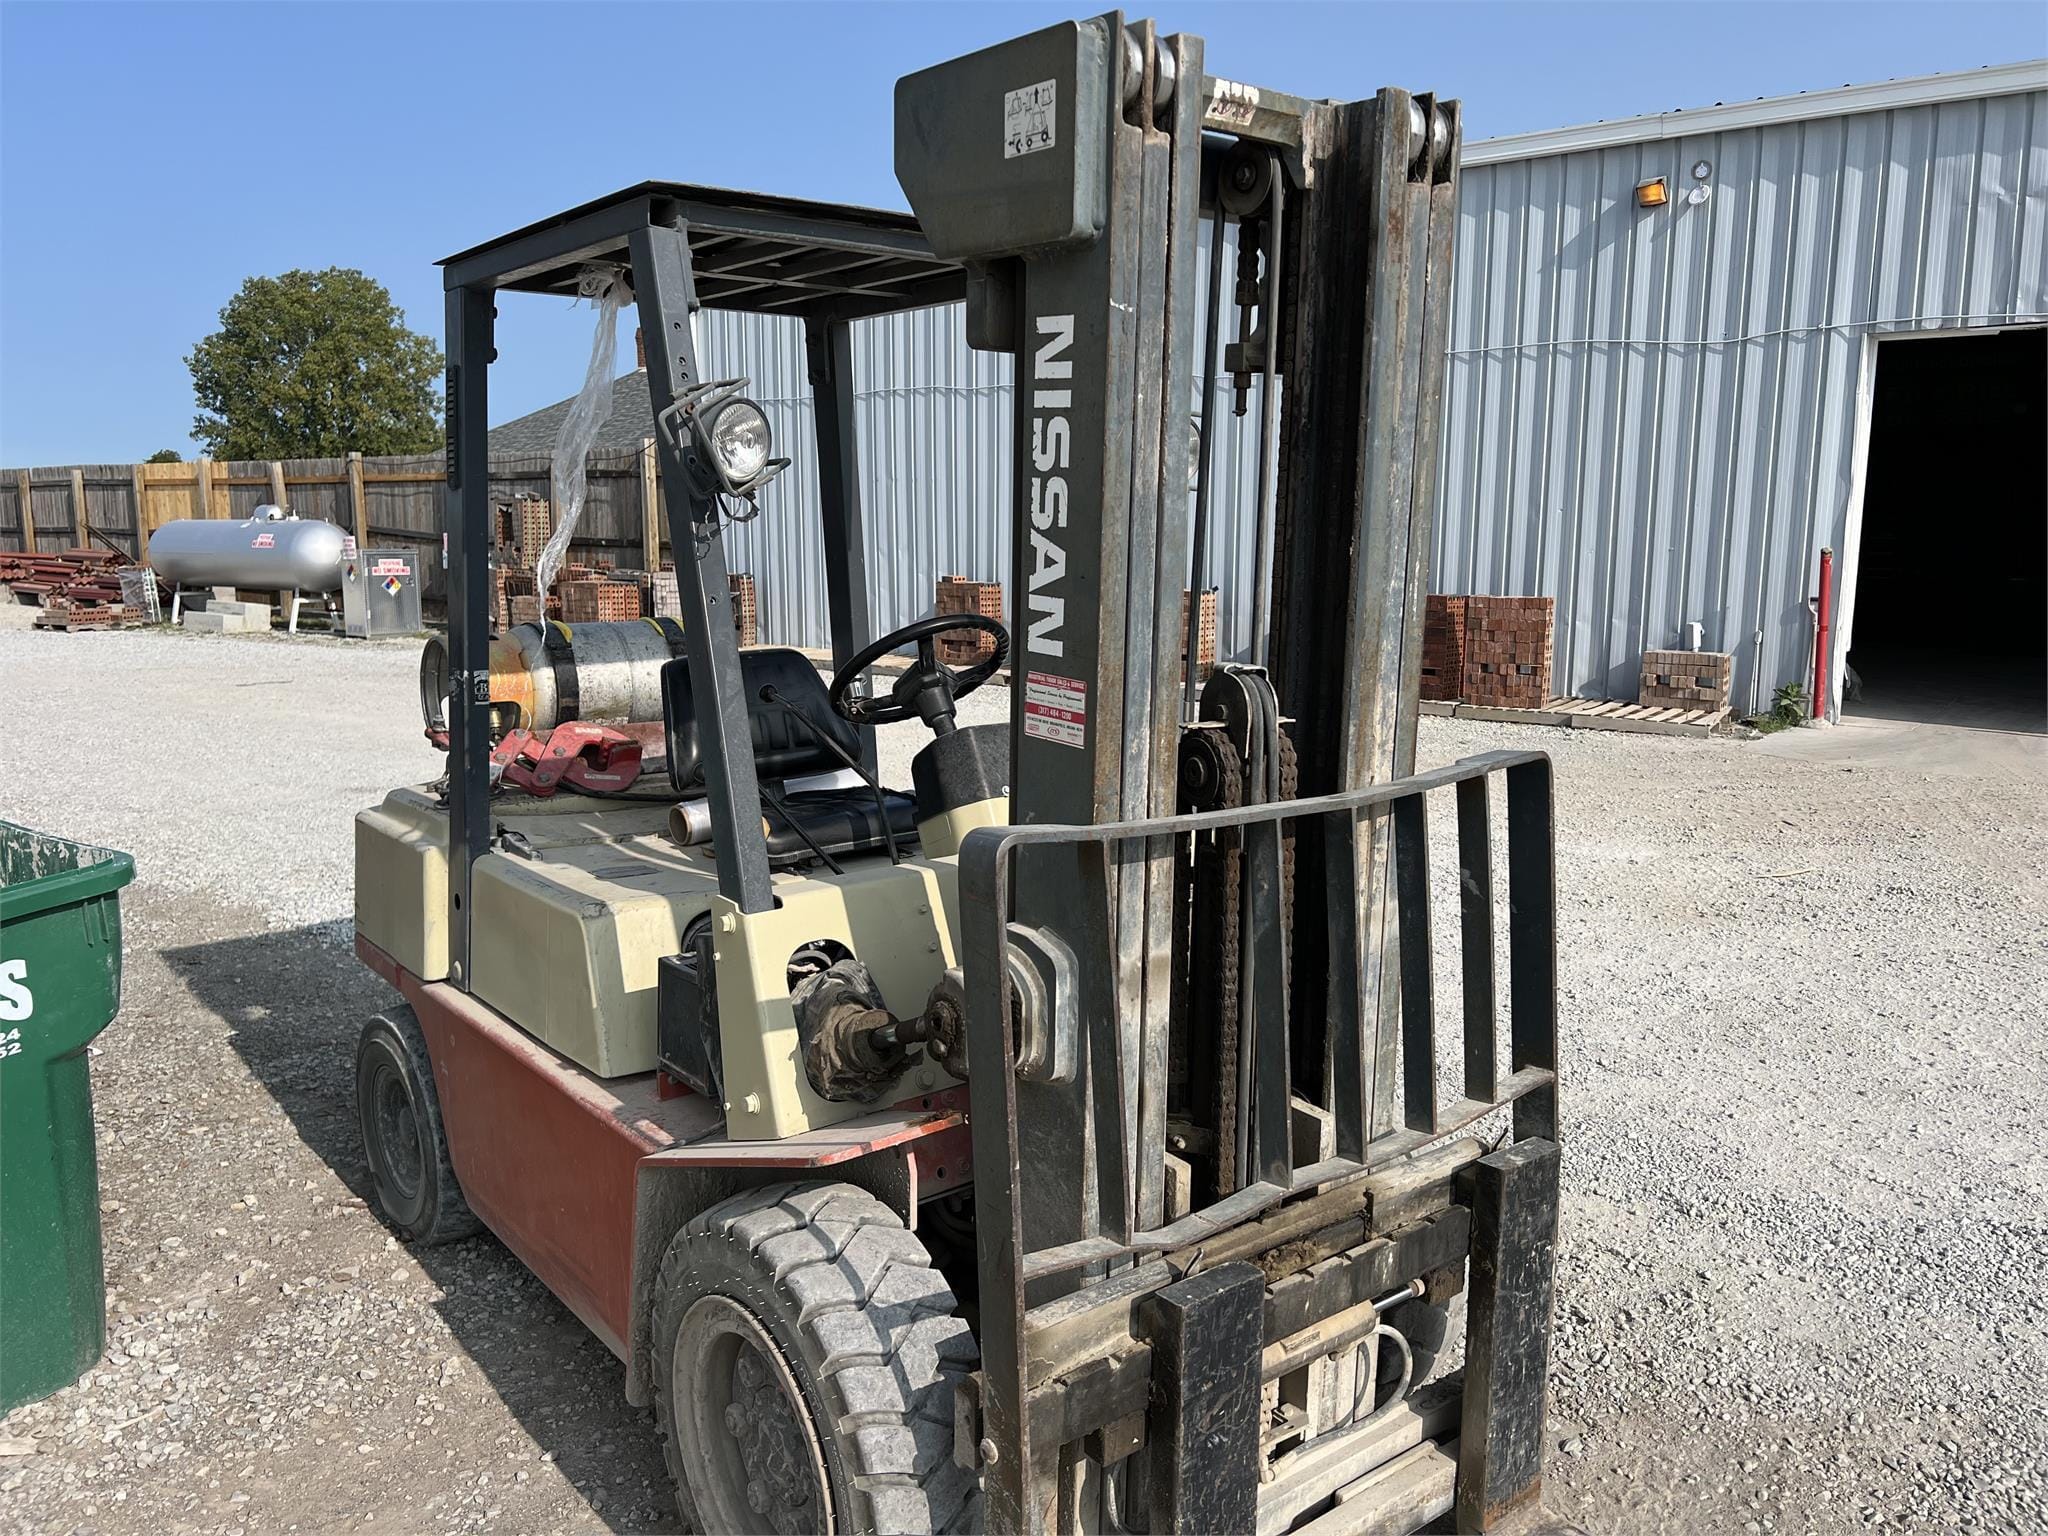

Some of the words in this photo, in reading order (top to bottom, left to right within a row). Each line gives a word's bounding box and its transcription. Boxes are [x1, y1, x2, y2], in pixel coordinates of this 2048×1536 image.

[373, 567, 383, 575] NO
[383, 567, 410, 575] SMOKING
[1028, 314, 1075, 657] NISSAN
